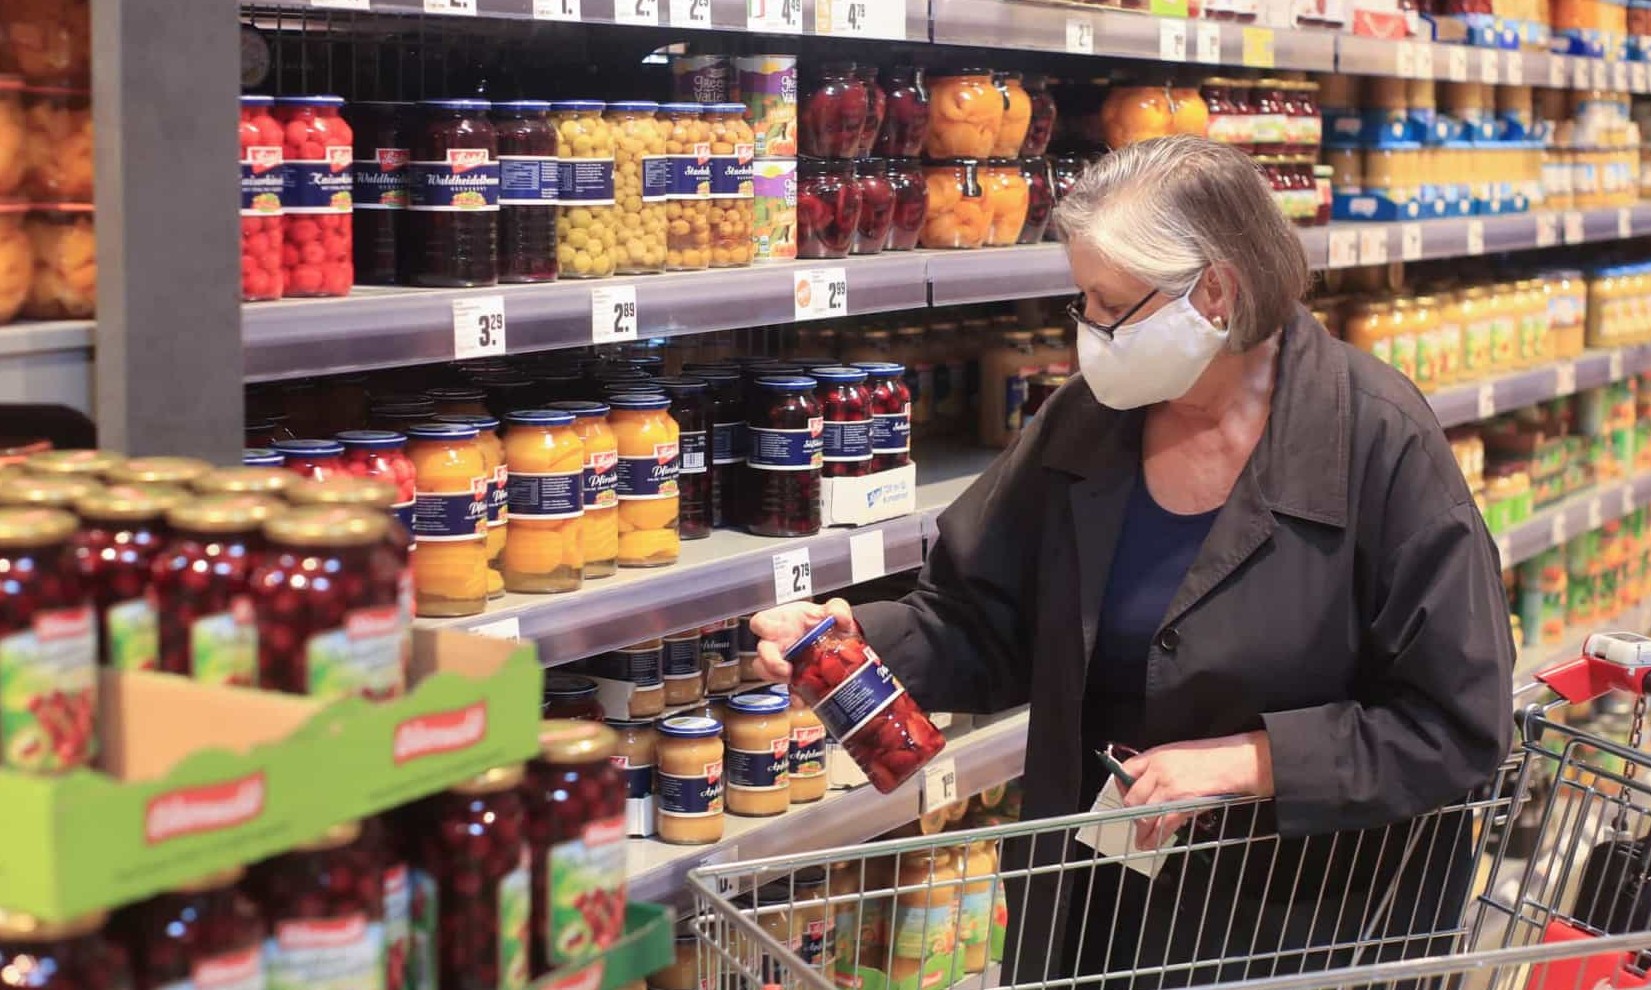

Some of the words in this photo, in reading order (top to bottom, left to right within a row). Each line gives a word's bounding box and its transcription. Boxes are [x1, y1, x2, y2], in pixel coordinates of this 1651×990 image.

[828, 281, 845, 308] 2.99
[478, 314, 503, 346] 3.29
[613, 302, 635, 332] 2.89
[792, 562, 810, 592] 2.79
